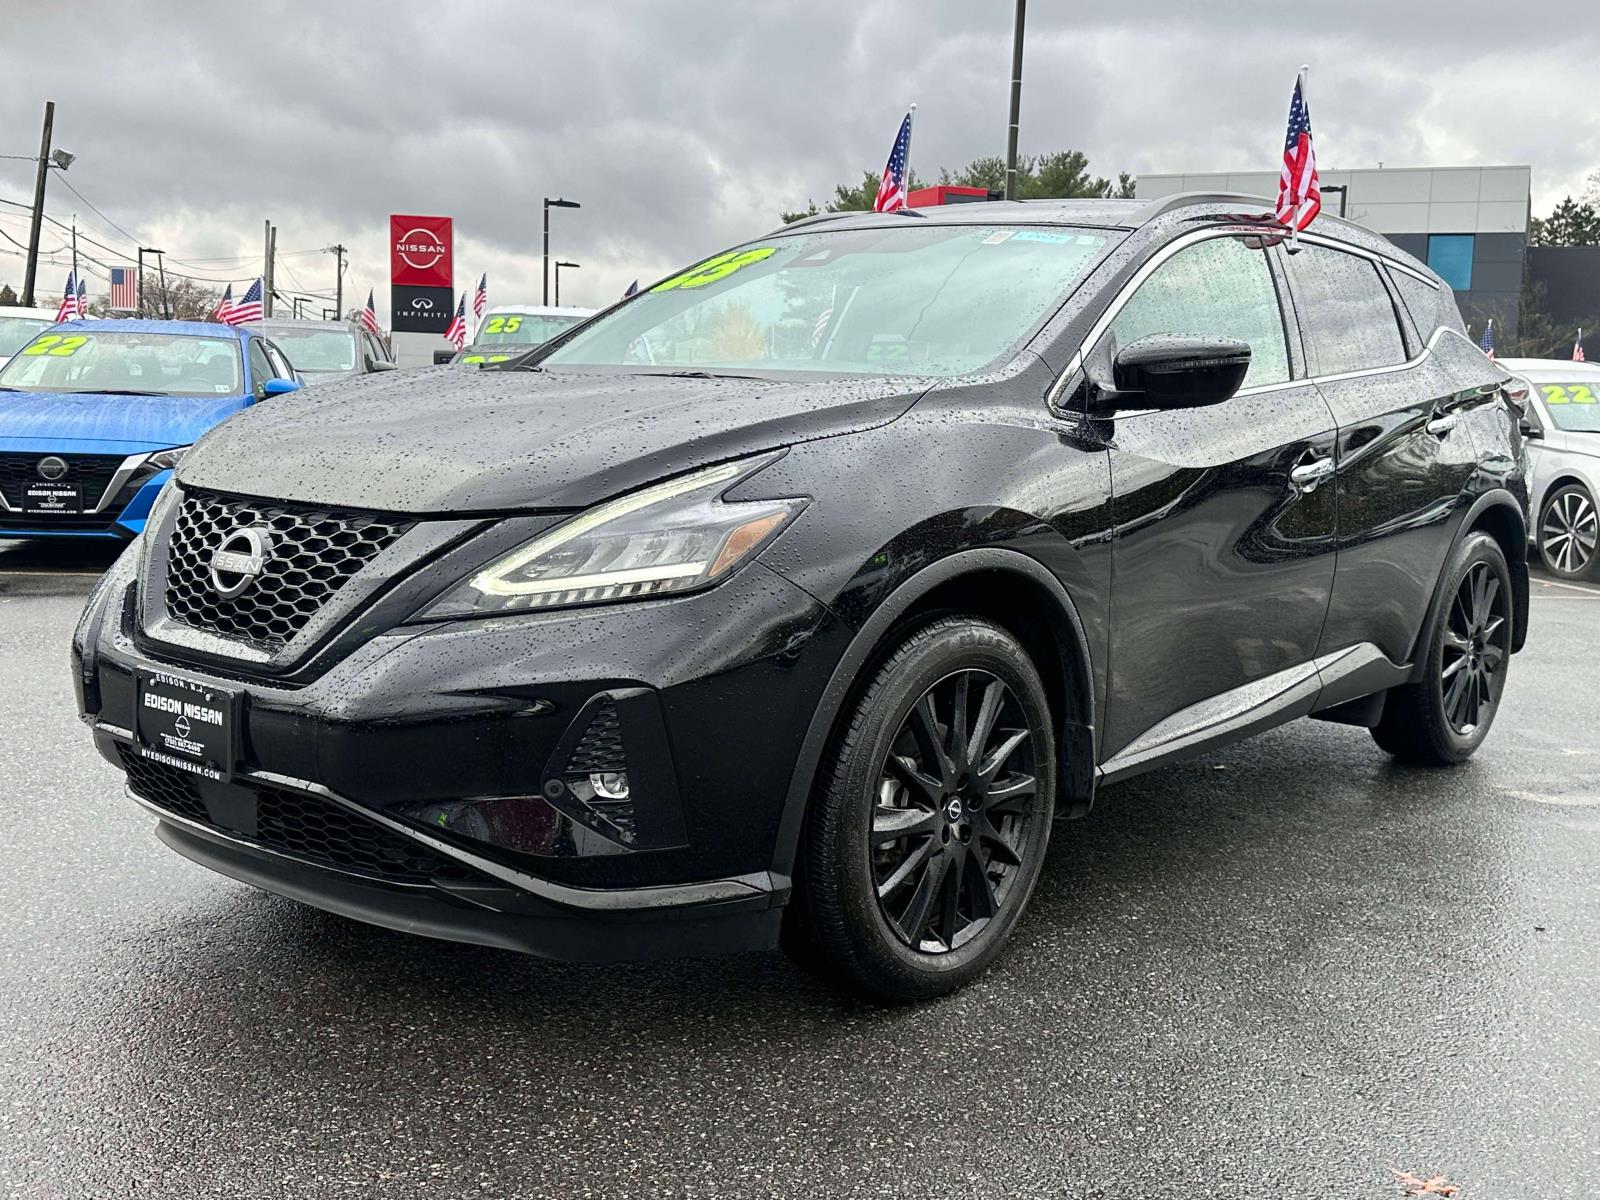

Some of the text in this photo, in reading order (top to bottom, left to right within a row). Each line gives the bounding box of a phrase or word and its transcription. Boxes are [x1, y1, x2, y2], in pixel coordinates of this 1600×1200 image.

[396, 243, 446, 254] NISSAN
[397, 310, 447, 319] INFINITI
[485, 316, 523, 334] 25
[23, 335, 87, 356] 22
[1541, 384, 1598, 405] 22
[155, 674, 187, 690] EDISON,
[144, 692, 223, 726] EDISON NISSAN
[141, 748, 220, 781] MYEDISONNISSAN.COM
